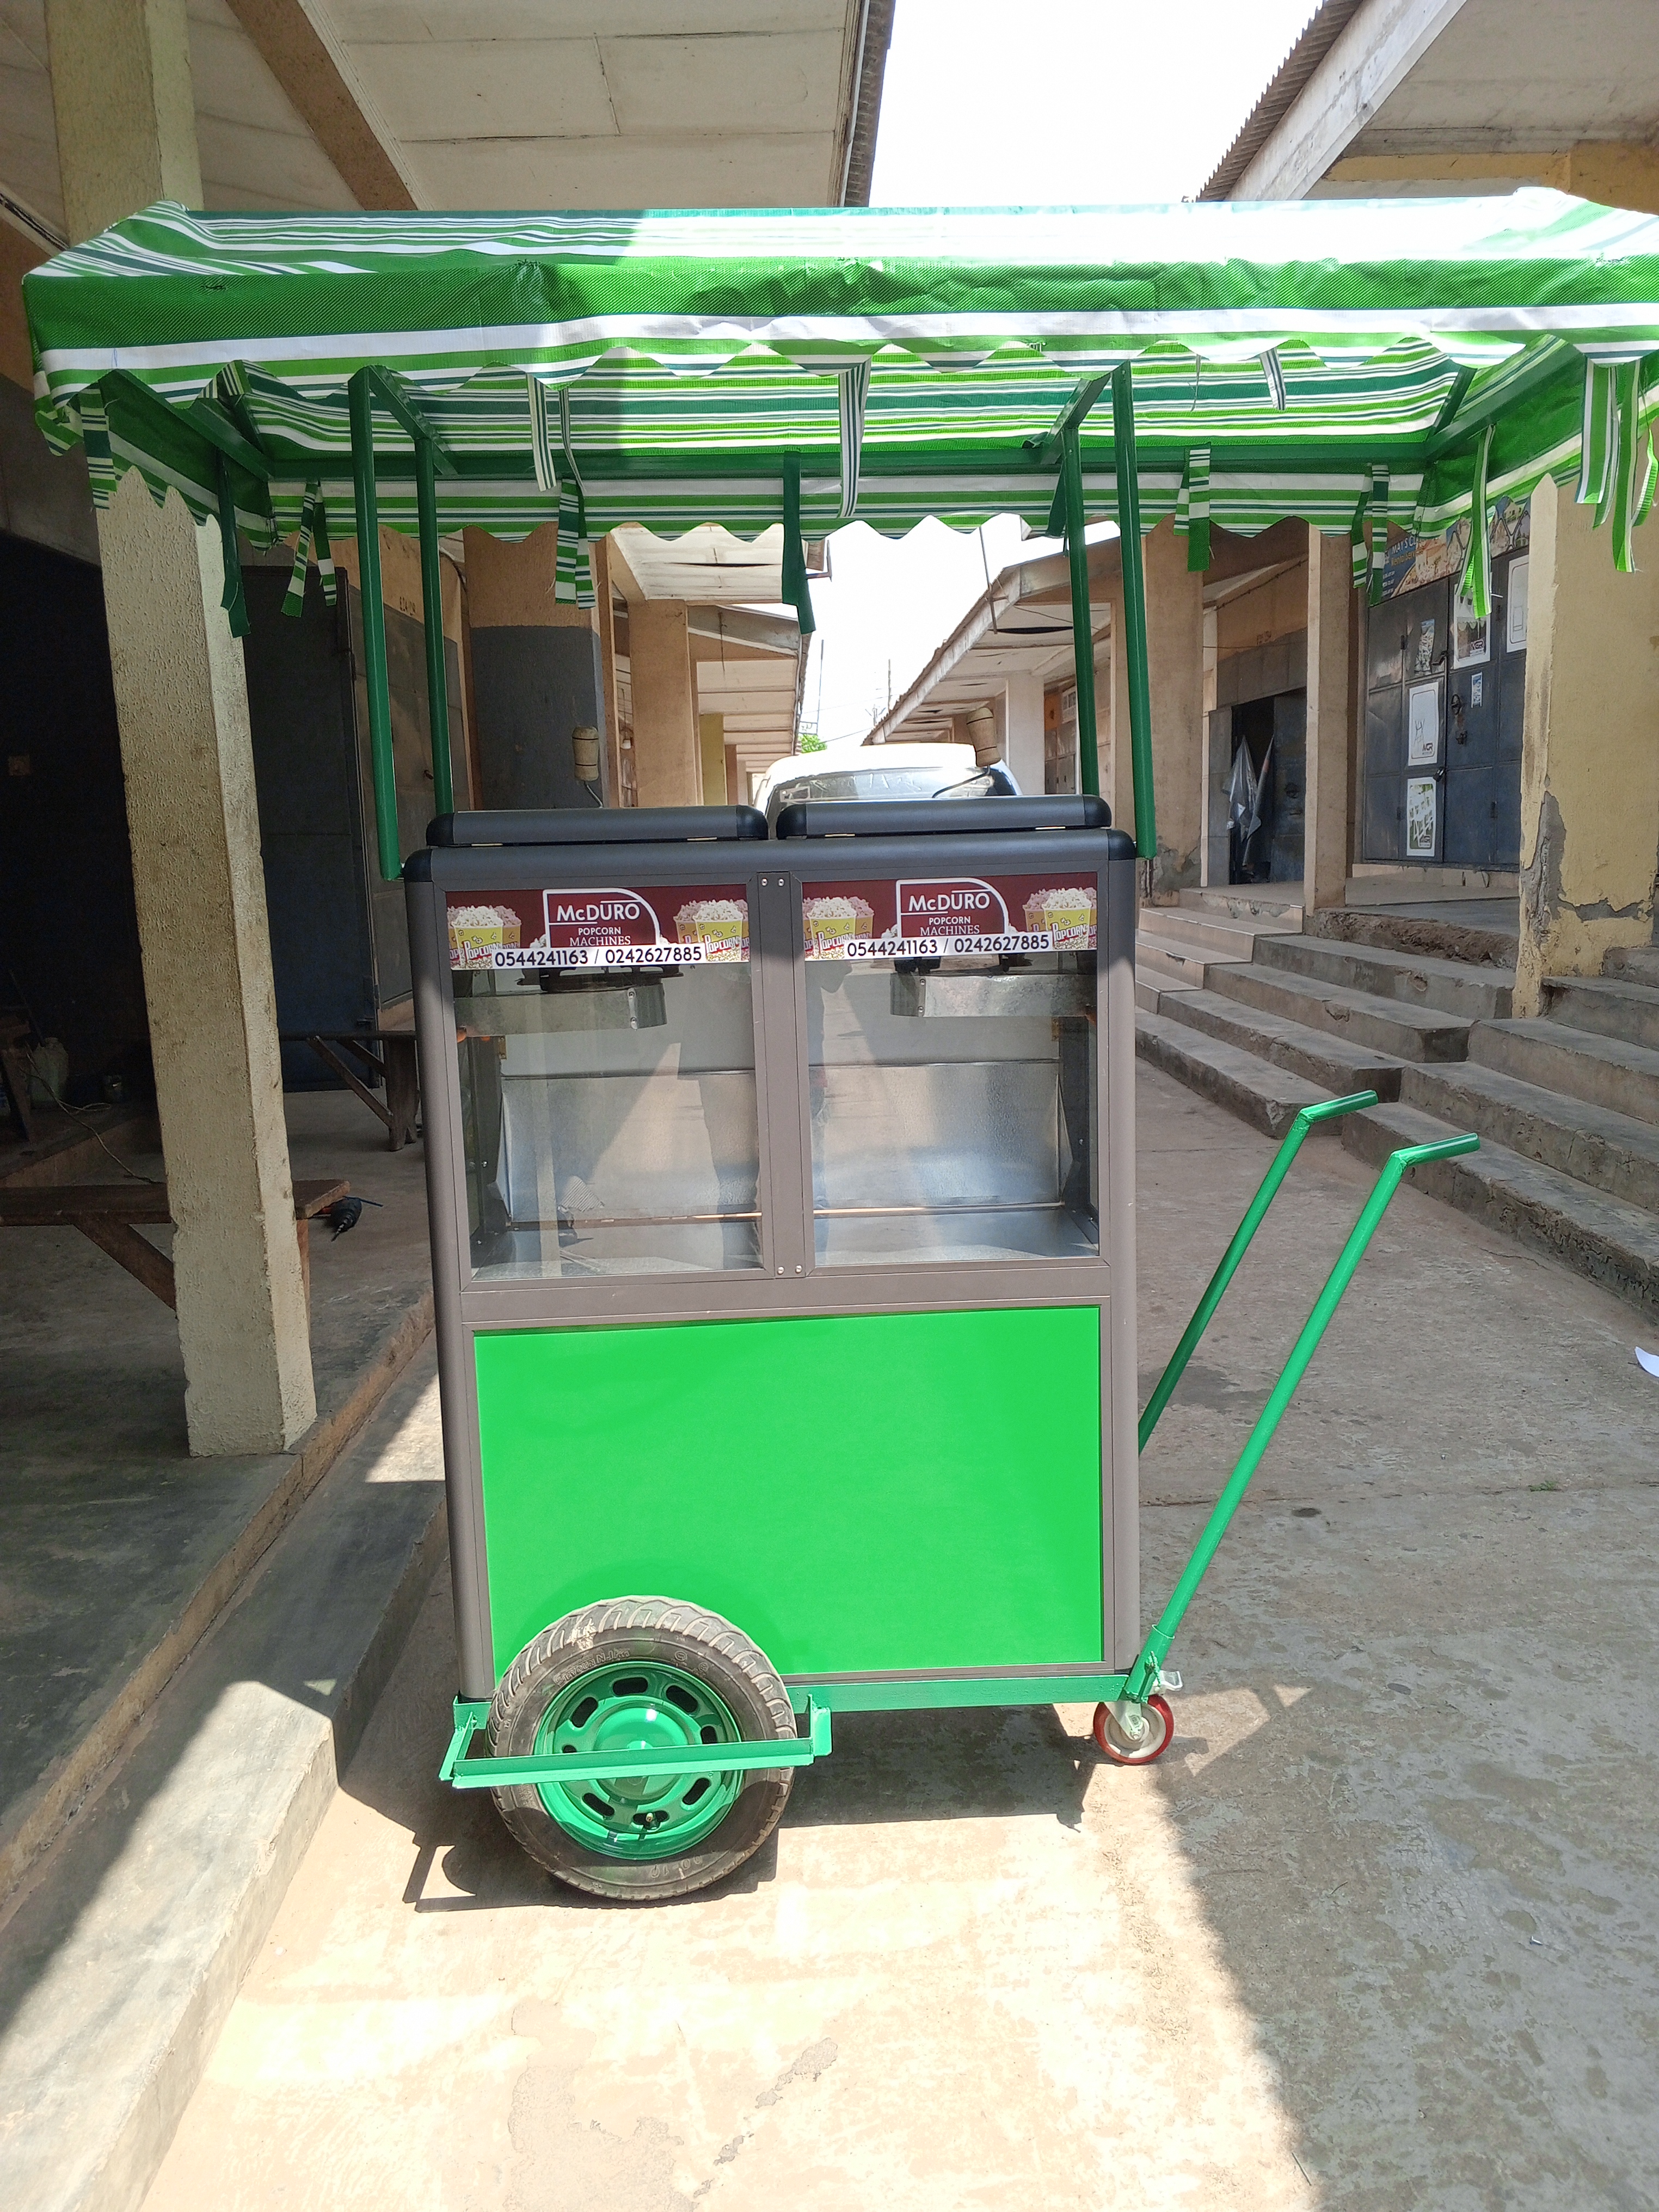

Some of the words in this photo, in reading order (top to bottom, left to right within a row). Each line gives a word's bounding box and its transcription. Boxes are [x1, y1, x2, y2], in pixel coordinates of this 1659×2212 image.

[908, 893, 990, 911] McDURO
[556, 904, 640, 921] McDURO
[929, 916, 970, 925] POPCORN
[578, 927, 621, 936] POPCORN
[920, 925, 980, 936] MACHINES
[569, 936, 631, 946] MACHINES
[847, 939, 937, 957] 0544241163
[943, 938, 949, 954] /
[954, 935, 1049, 953] 0242627885
[495, 950, 588, 967] 0544241163
[594, 949, 599, 964] /
[605, 947, 702, 964] 0242627885
